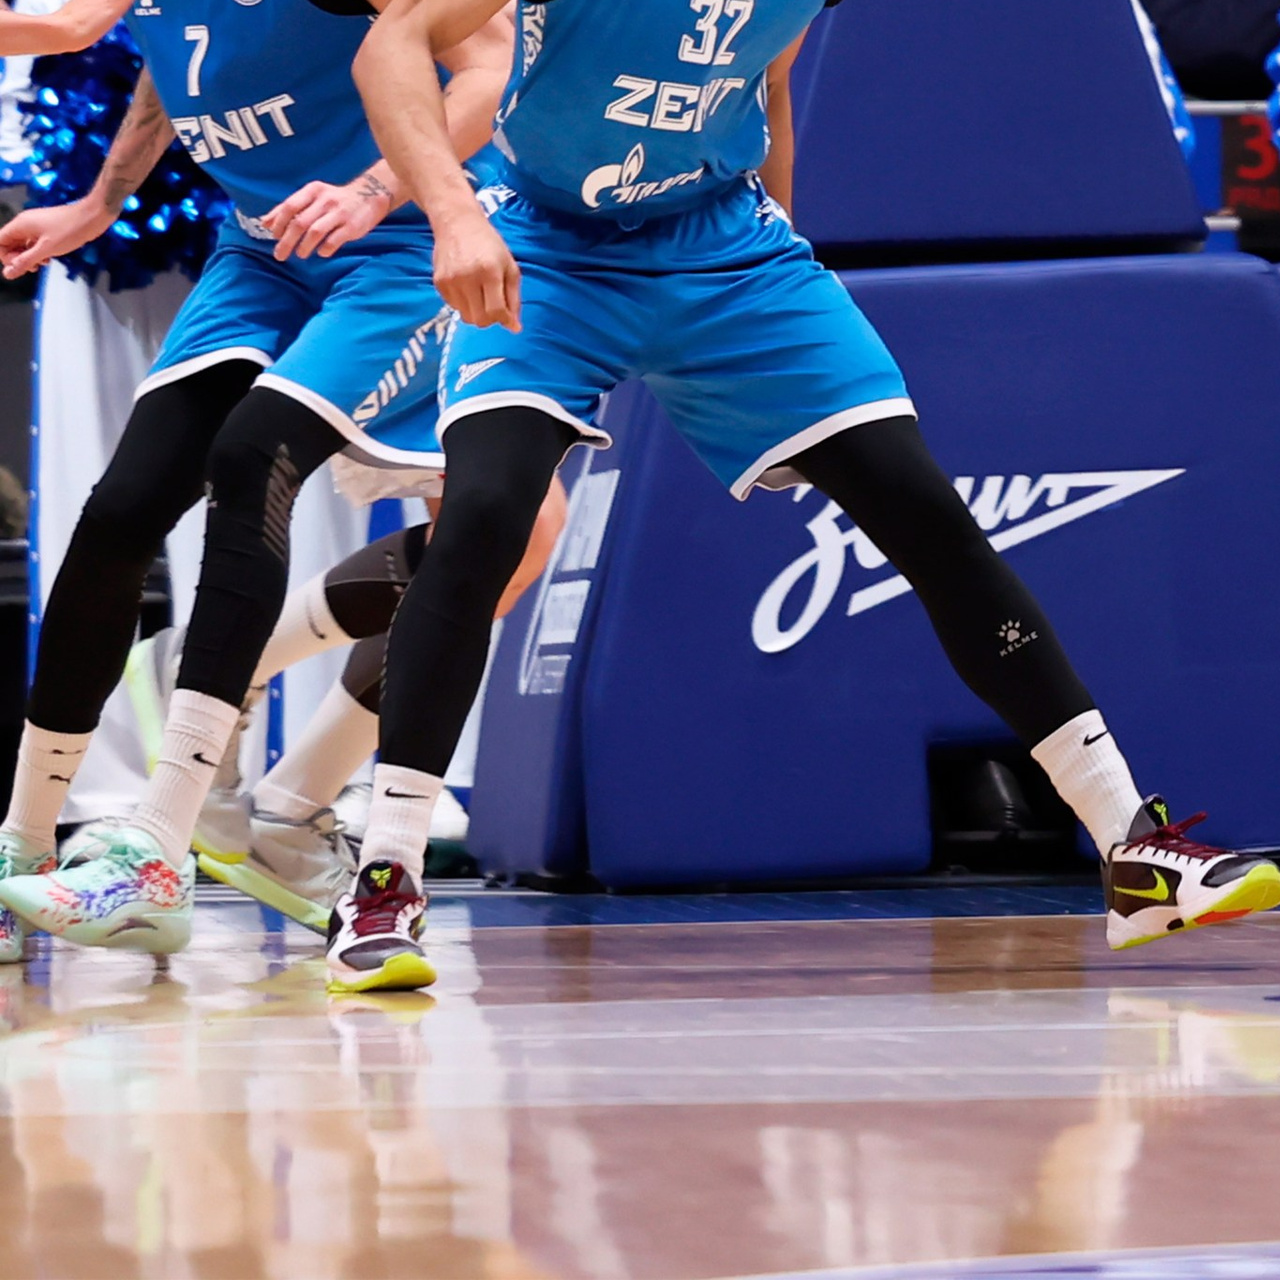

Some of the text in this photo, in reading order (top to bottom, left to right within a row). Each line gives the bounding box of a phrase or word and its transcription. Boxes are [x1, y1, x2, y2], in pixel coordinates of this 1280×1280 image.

[184, 25, 210, 97] 7
[171, 93, 296, 163] ENIT
[999, 631, 1038, 657] KELME
